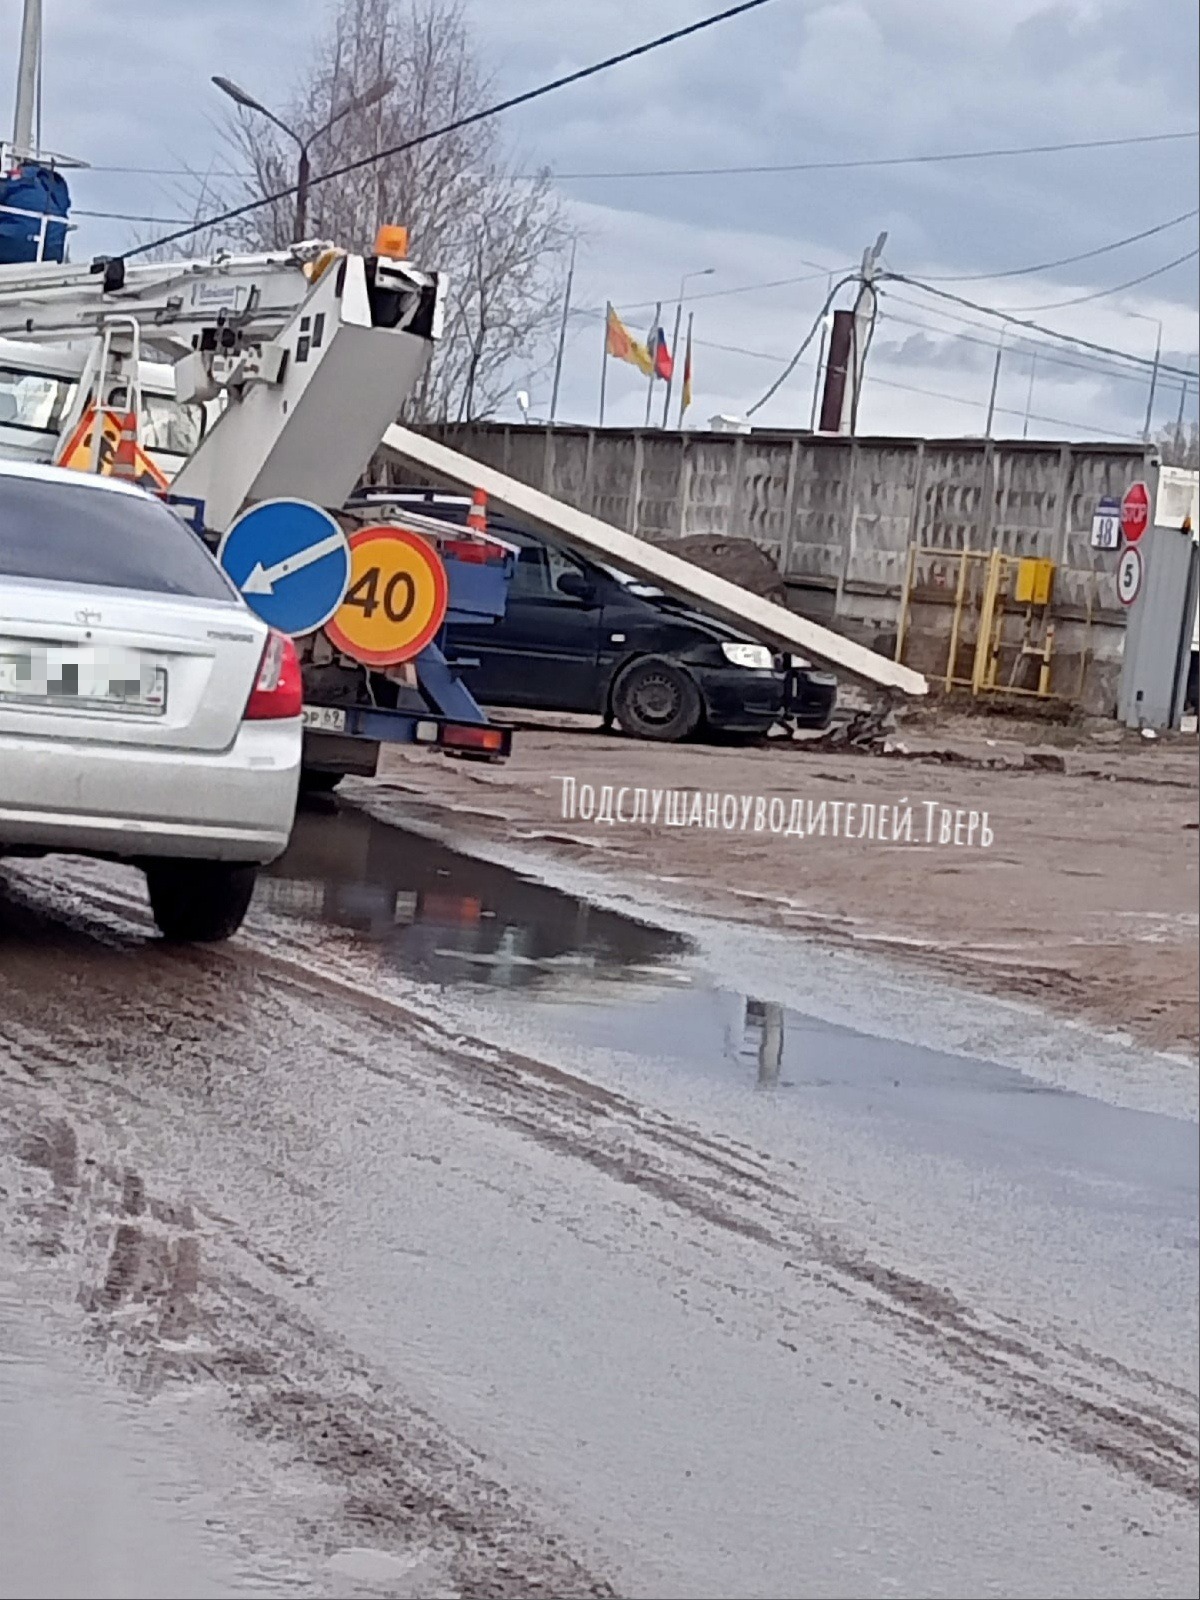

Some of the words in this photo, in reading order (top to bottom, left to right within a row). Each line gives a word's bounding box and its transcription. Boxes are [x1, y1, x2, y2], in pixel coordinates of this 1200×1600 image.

[1122, 503, 1147, 523] STOP
[1123, 563, 1134, 588] 5
[342, 567, 416, 623] 40
